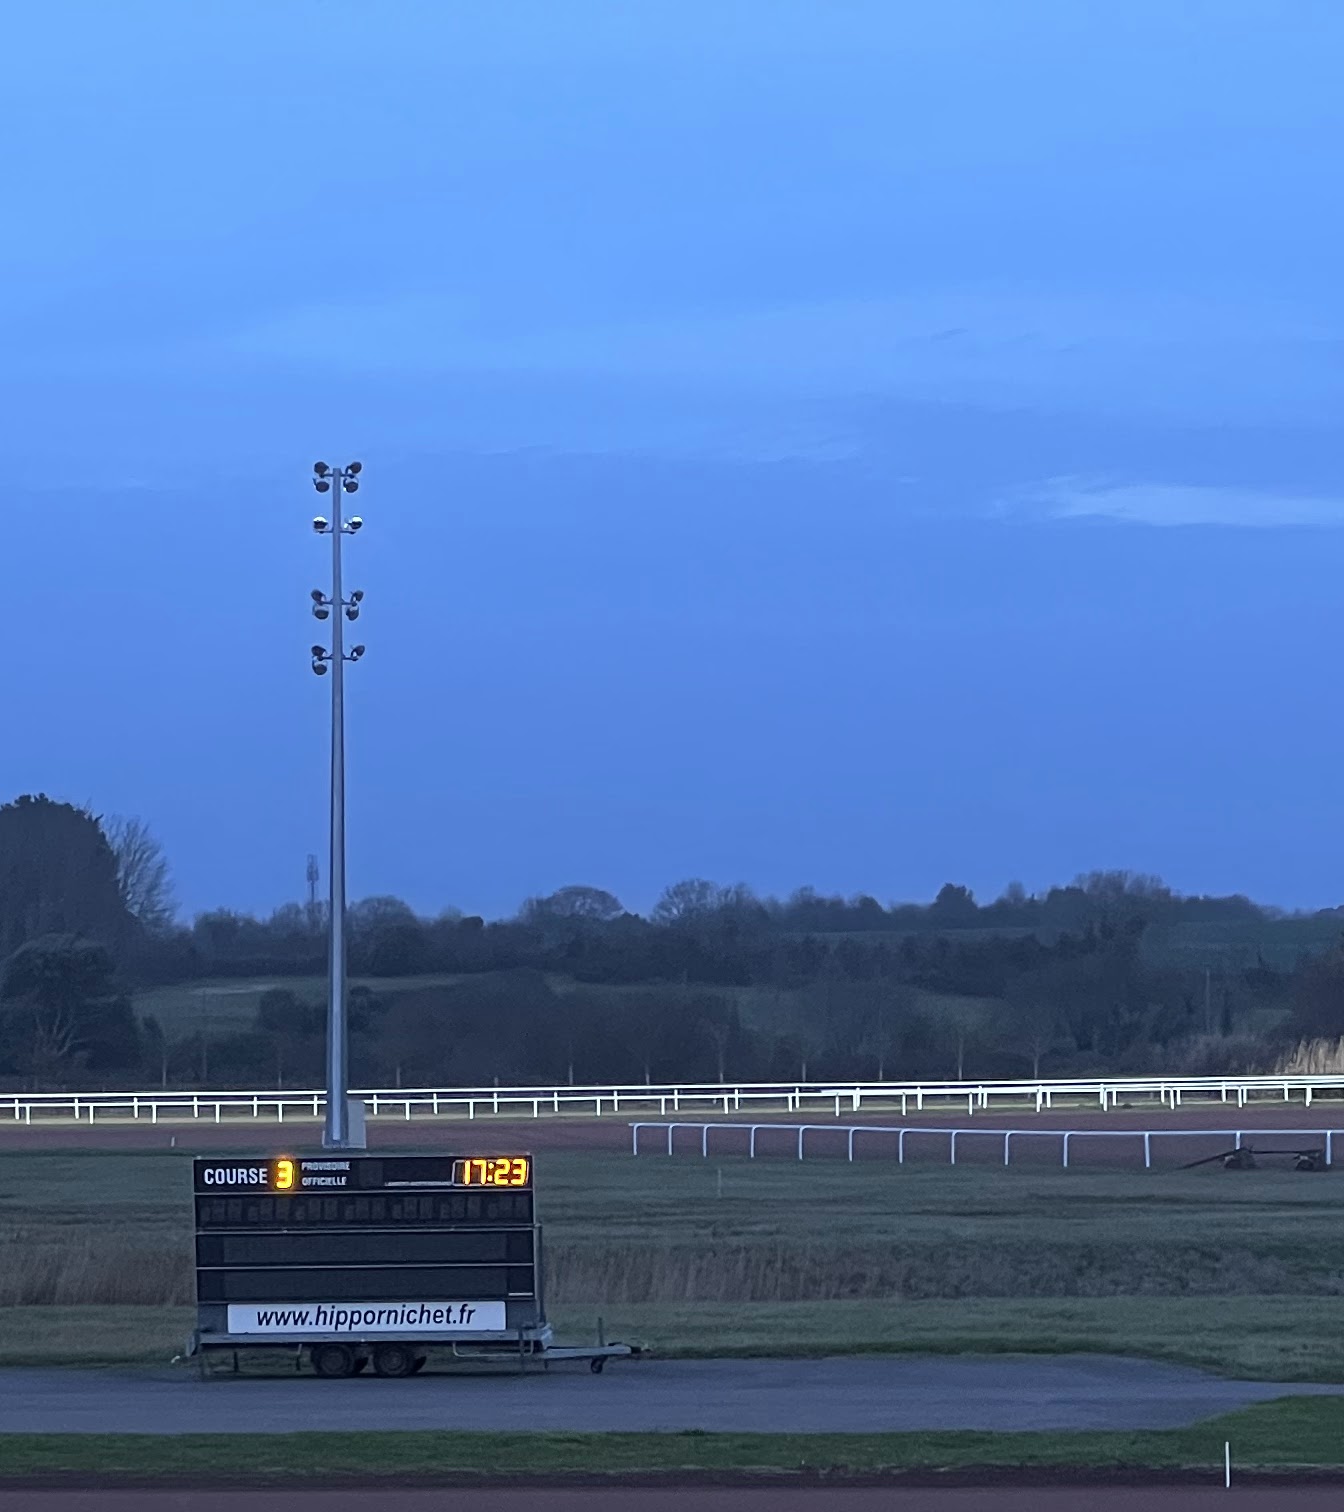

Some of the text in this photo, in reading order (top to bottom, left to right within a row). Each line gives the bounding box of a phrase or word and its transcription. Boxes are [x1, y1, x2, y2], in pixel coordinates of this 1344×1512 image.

[204, 1160, 294, 1189] COURSE 3
[301, 1176, 347, 1186] OFFICIELLE
[463, 1158, 527, 1185] 17:23
[257, 1304, 475, 1331] www.hippornichet.fr
